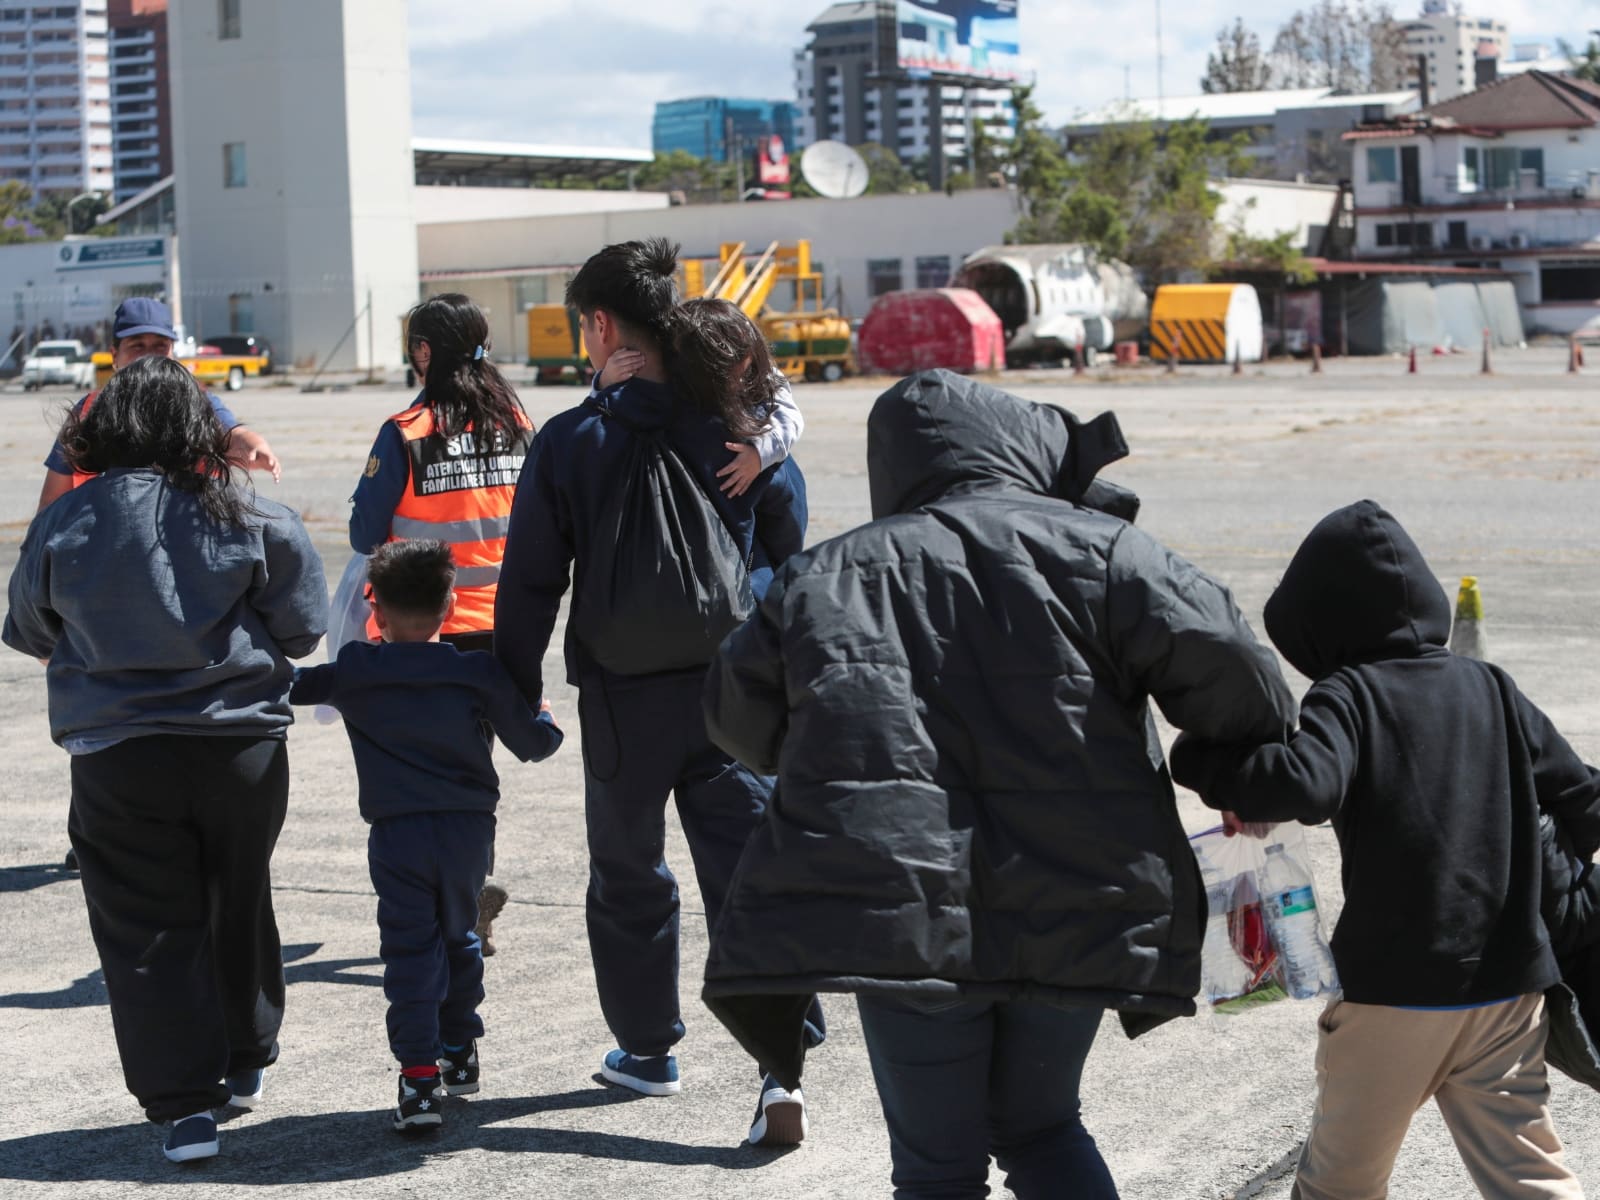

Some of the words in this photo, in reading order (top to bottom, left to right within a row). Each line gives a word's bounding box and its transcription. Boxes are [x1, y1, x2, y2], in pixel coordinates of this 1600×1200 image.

[426, 456, 478, 479] ATENCIÓN
[479, 457, 486, 472] A
[488, 455, 526, 471] UNIDAD
[422, 472, 485, 495] FAMILIARES
[486, 470, 521, 486] MIGRA
